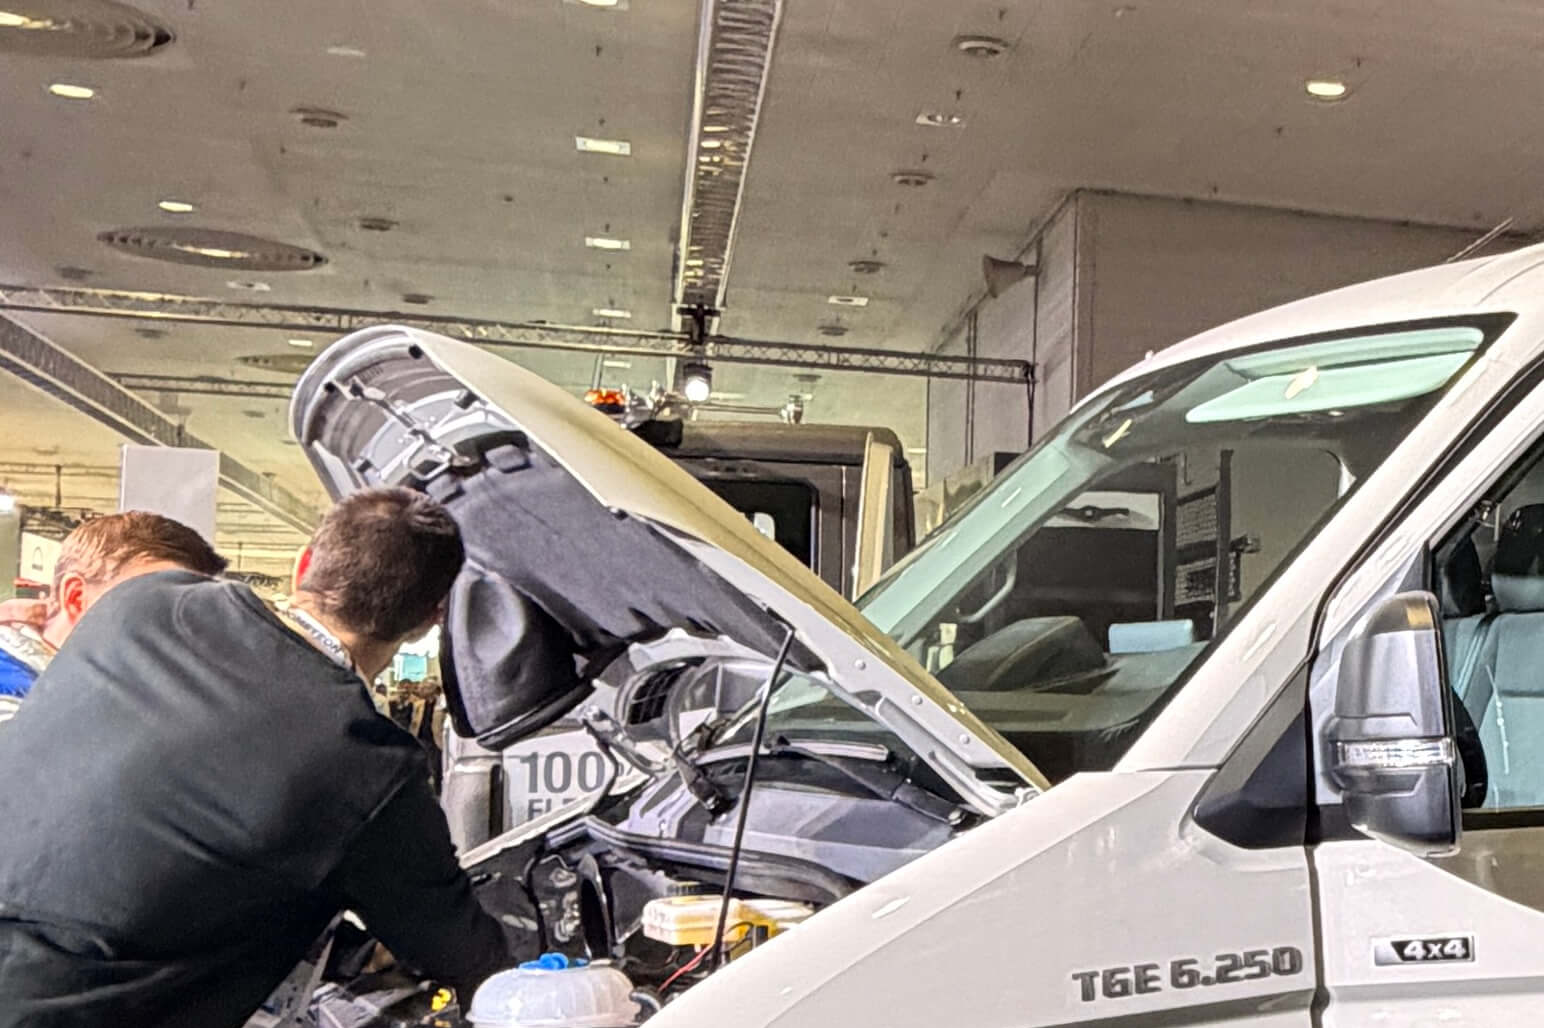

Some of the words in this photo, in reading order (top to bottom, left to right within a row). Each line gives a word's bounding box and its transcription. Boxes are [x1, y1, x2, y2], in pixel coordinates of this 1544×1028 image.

[1403, 939, 1467, 960] 4x4
[1071, 963, 1163, 1002] TGE
[1169, 946, 1304, 990] 6.250
